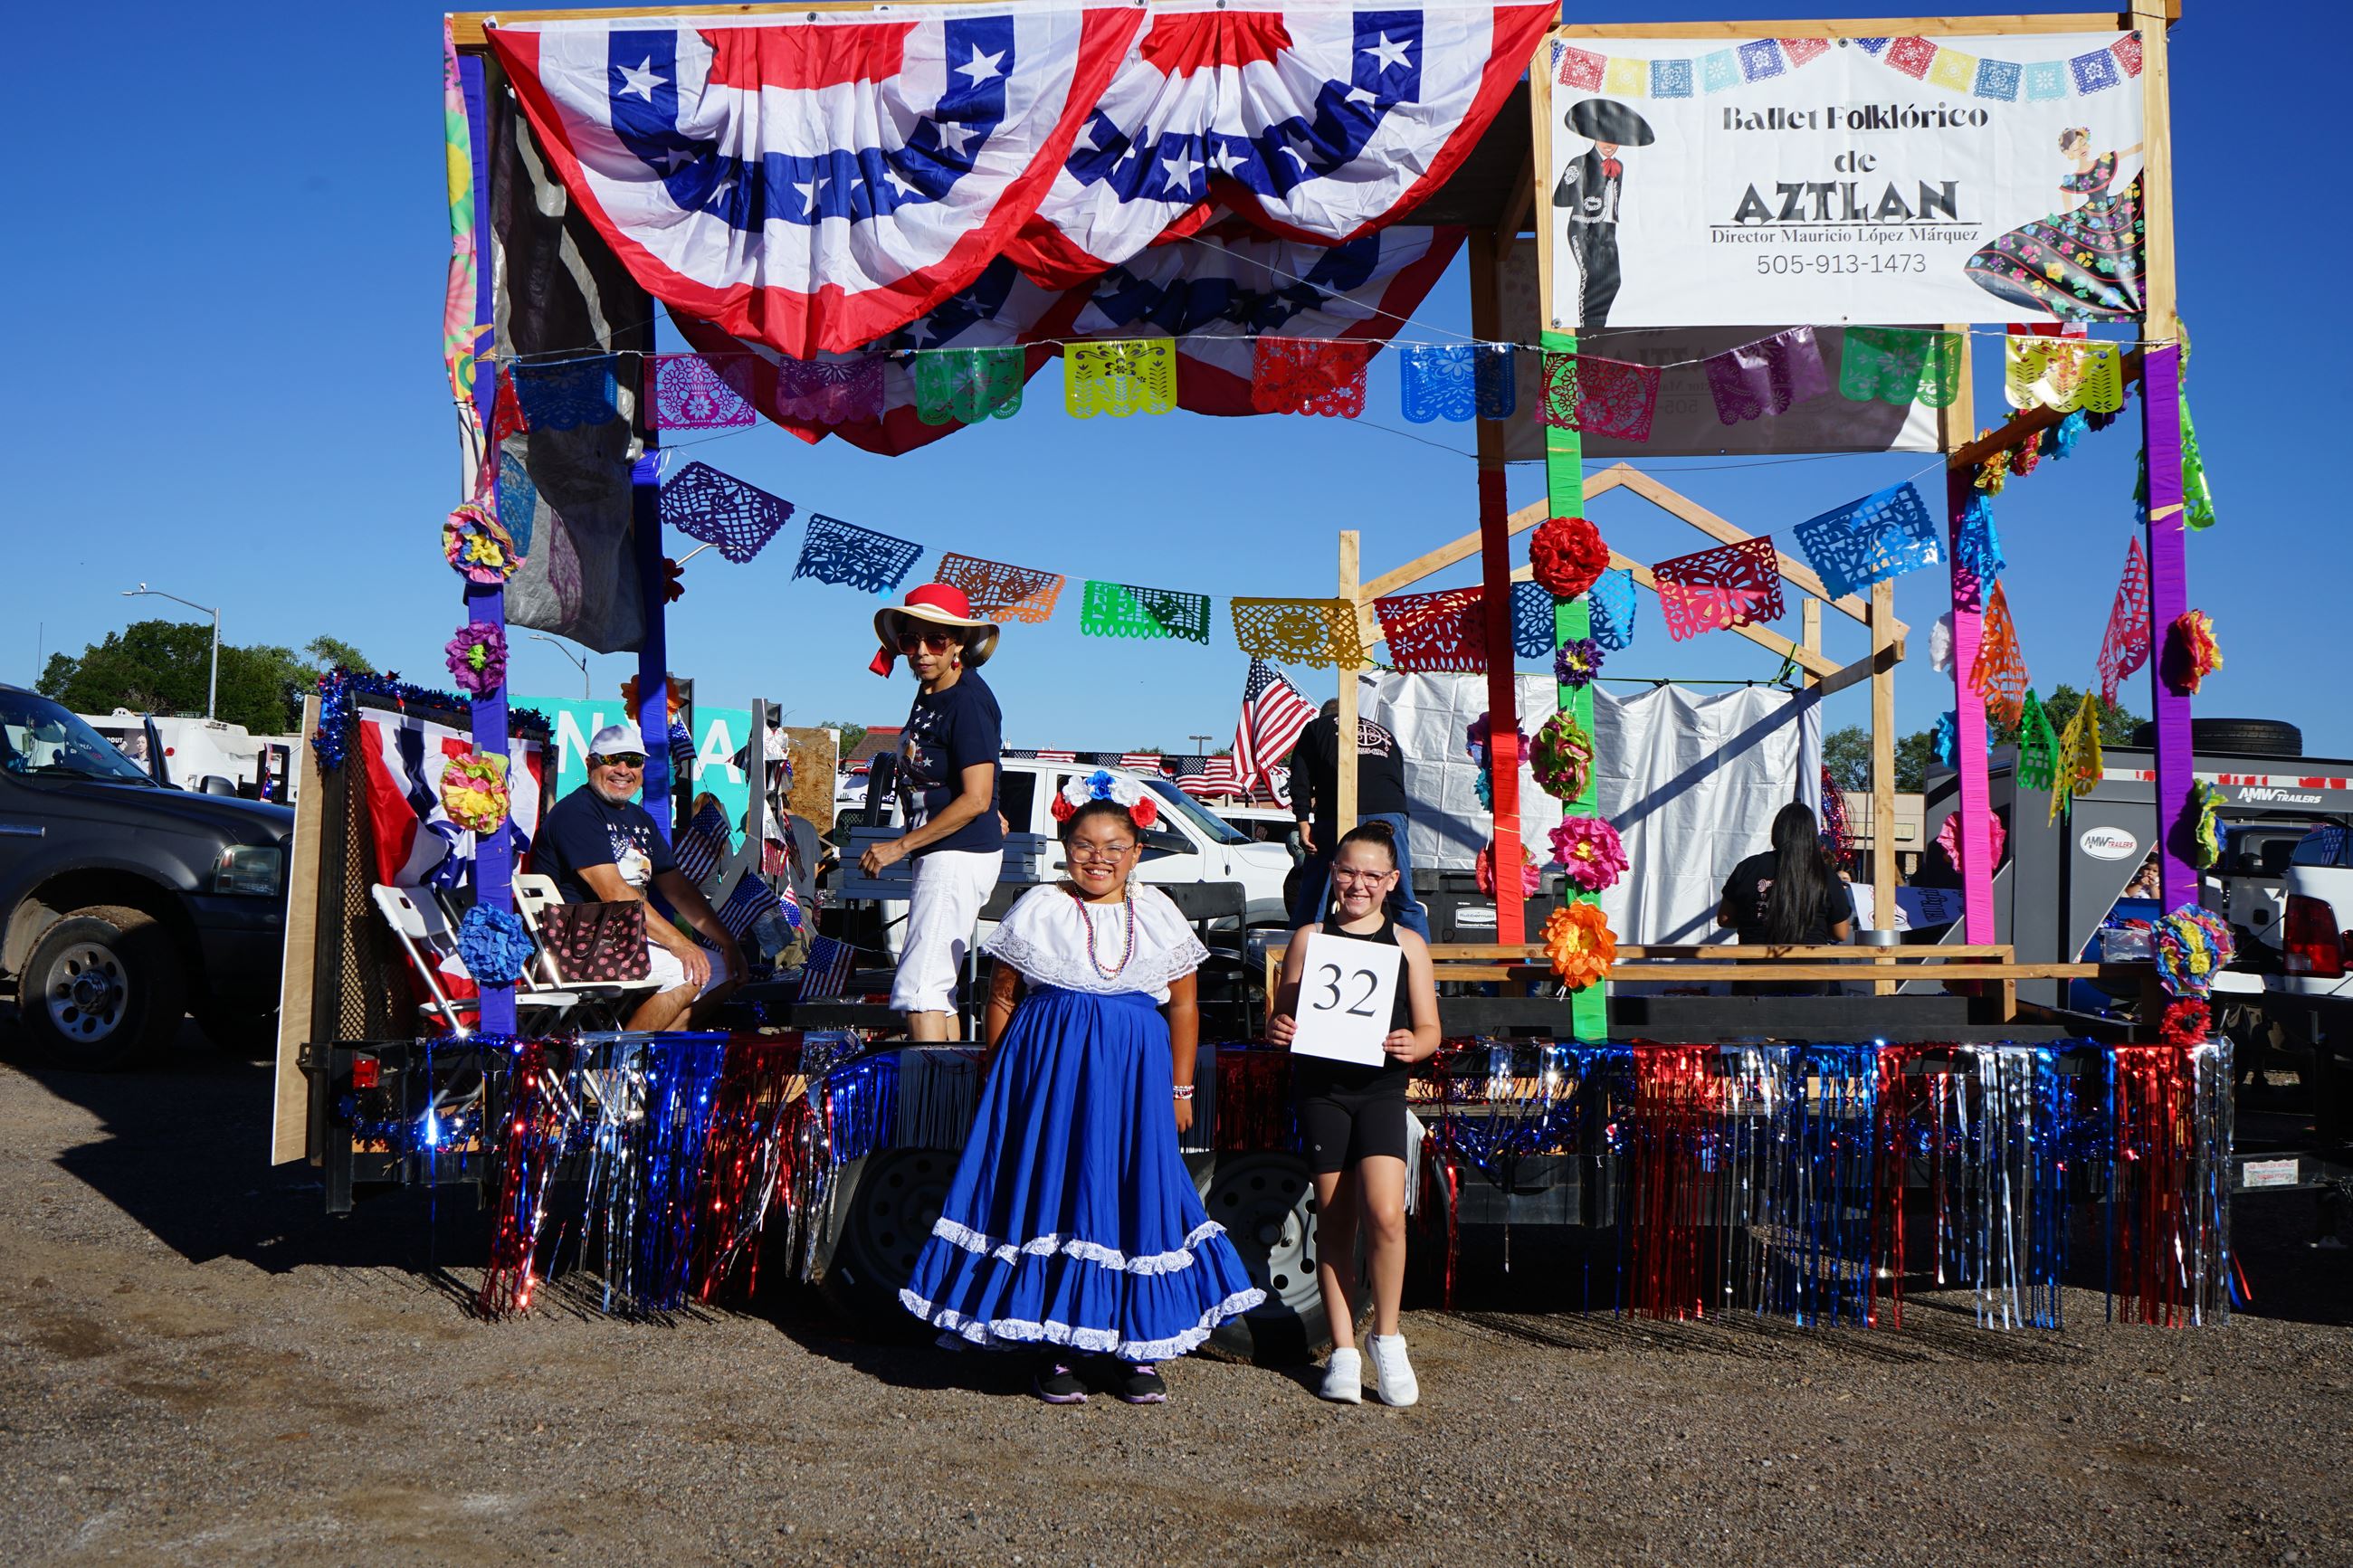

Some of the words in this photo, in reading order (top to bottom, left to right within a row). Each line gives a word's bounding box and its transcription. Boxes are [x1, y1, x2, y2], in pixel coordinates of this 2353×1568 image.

[1723, 106, 1818, 131] Ballet
[1827, 101, 1989, 130] Folklórico
[1834, 150, 1877, 173] de
[1730, 180, 1960, 225] AZTLAN
[1711, 229, 1776, 244] Director
[1781, 228, 1852, 243] Mauricio
[1858, 227, 1904, 245] López
[1910, 226, 1979, 244] Márquez
[1757, 253, 1927, 274] 505-913-1473
[2237, 787, 2283, 803] AMW
[2276, 794, 2322, 804] TRAILERS
[2084, 835, 2111, 849] AMW
[2108, 841, 2134, 849] TRAILERS
[1312, 963, 1378, 1018] 32
